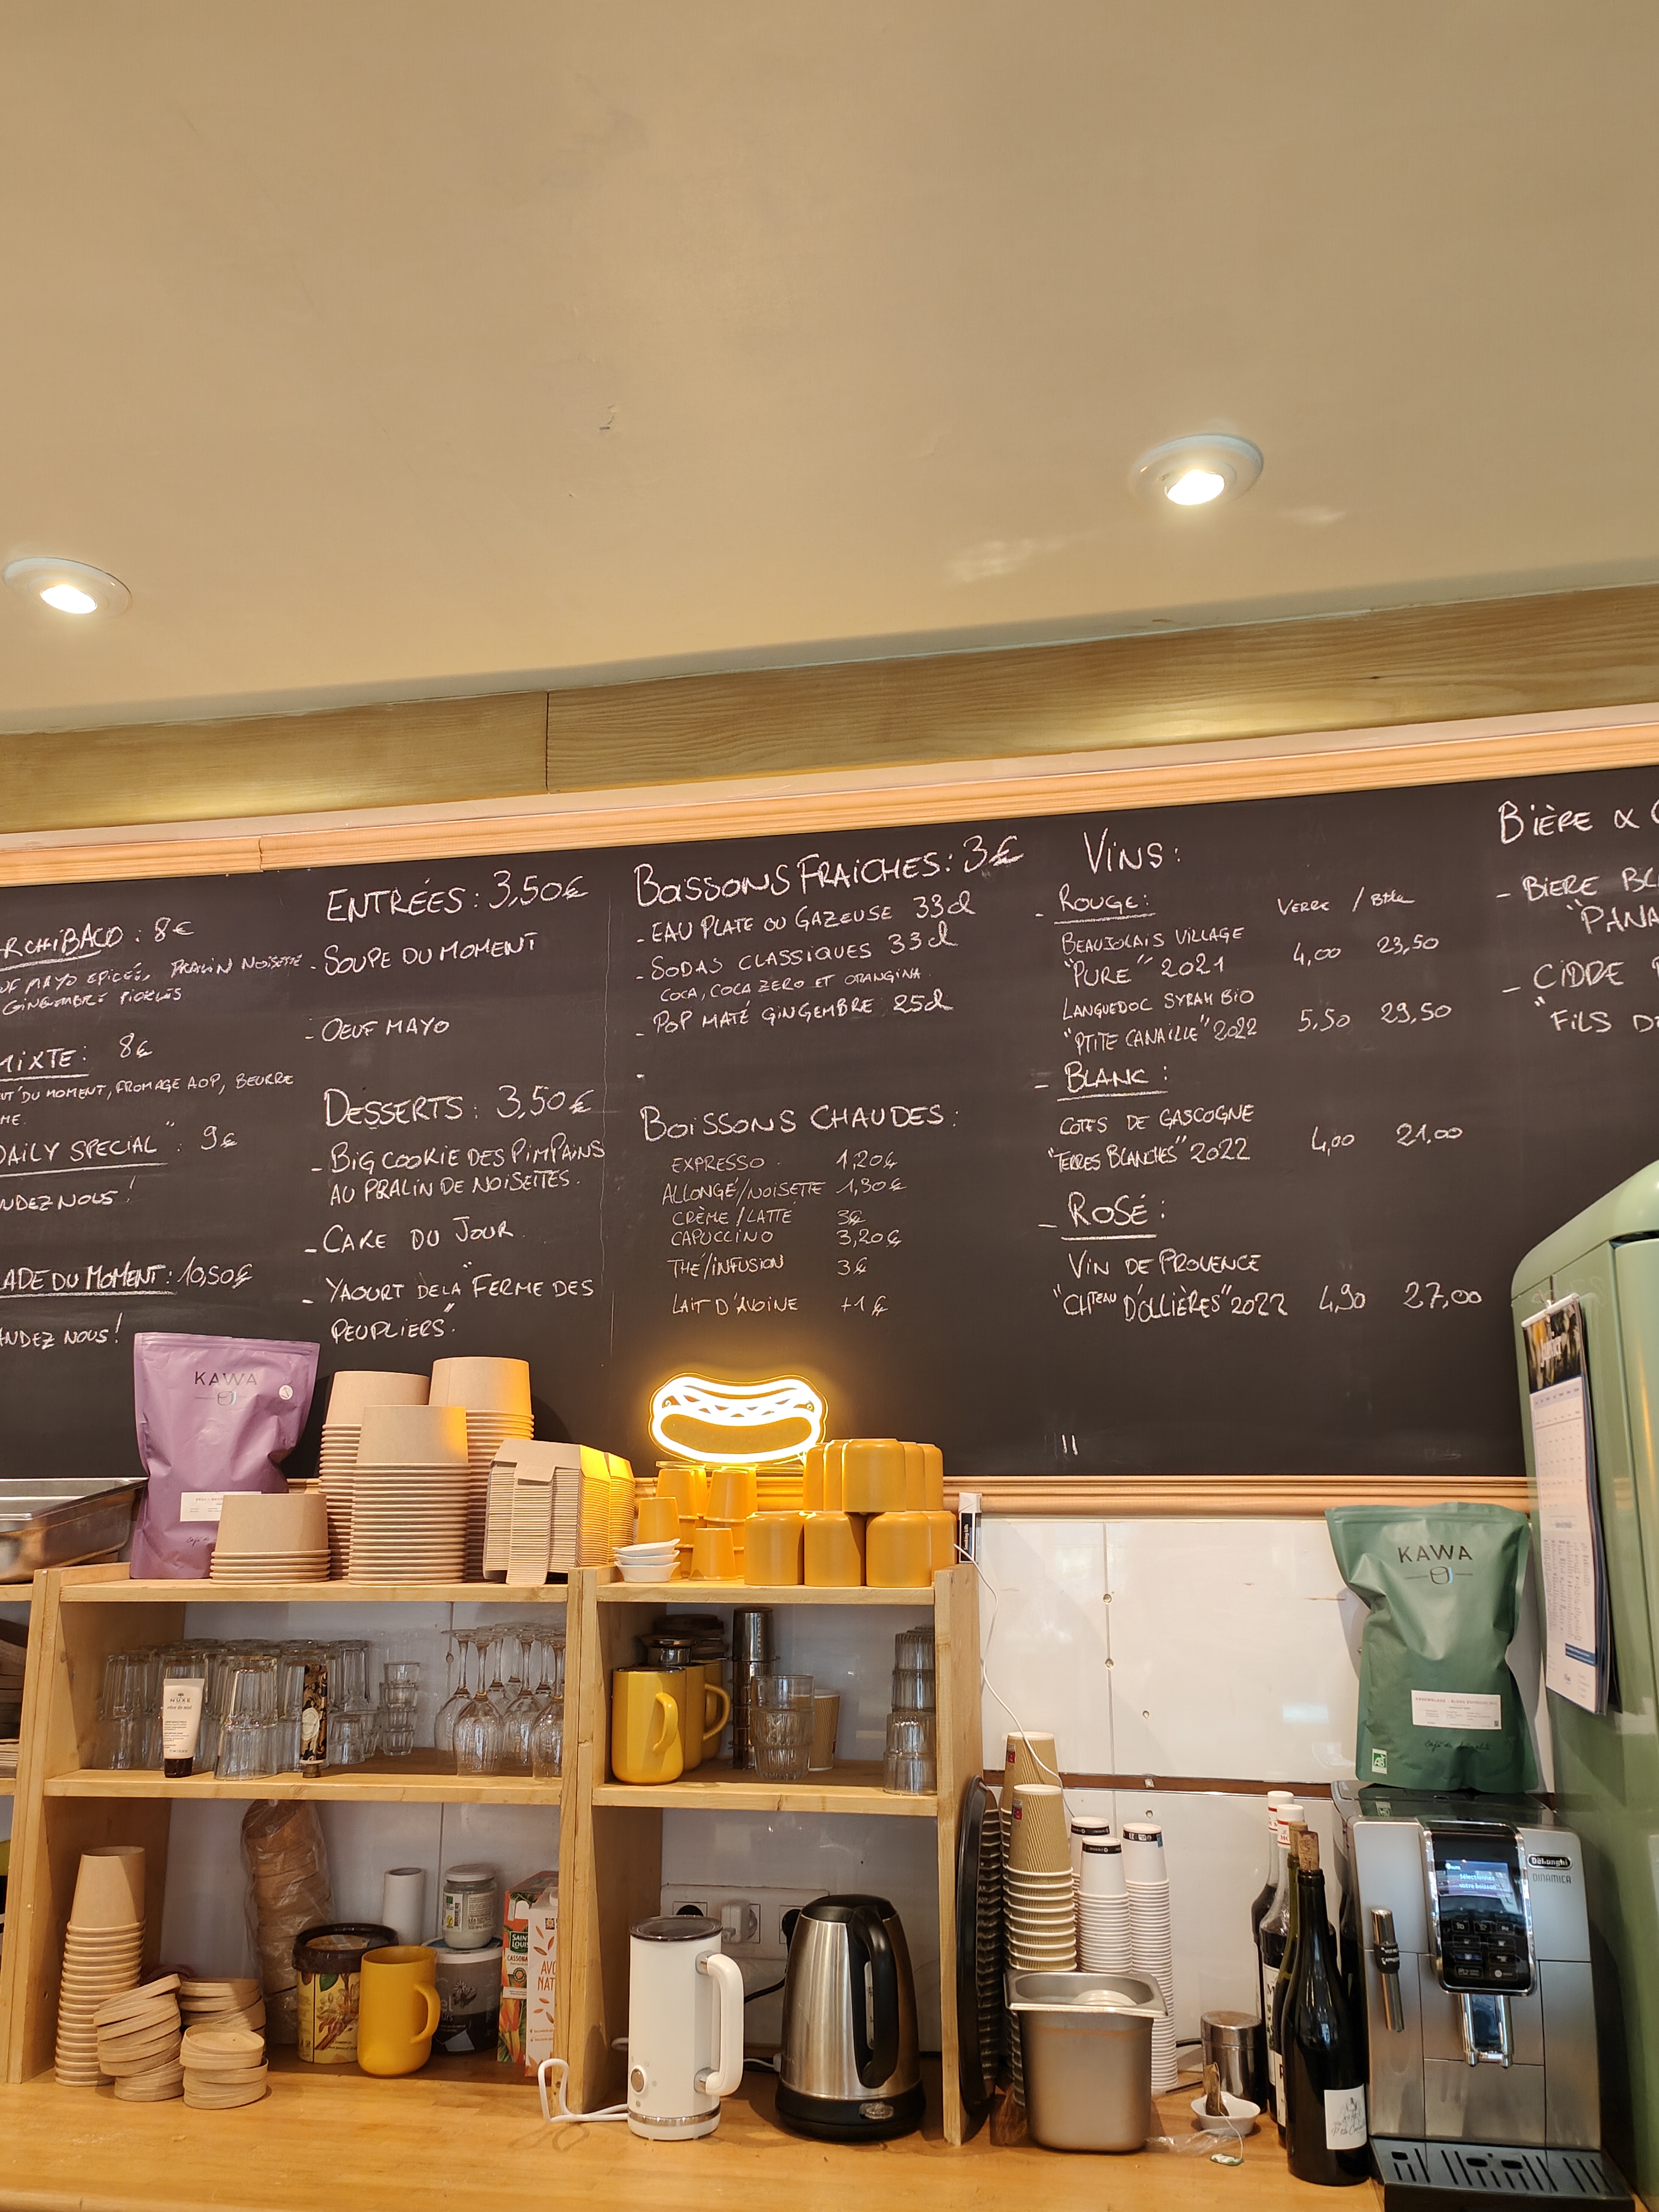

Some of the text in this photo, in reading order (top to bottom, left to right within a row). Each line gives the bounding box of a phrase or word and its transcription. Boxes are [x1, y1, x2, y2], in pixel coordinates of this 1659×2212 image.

[1498, 800, 1593, 845] BIÈRE
[1083, 827, 1181, 874] VINS:
[489, 869, 589, 909] 3,50€
[1058, 883, 1149, 913] ROUGE:
[1277, 898, 1330, 916] VERRE
[154, 916, 194, 942] 8€
[652, 921, 693, 943] EAU
[700, 914, 754, 940] PLATE
[764, 916, 786, 932] OU
[795, 905, 893, 932] GAZEUSE
[324, 932, 538, 976] SOUPE DU MOMENT
[651, 955, 723, 981] SODAS
[738, 942, 872, 970] CLASSIQUES
[1062, 927, 1439, 967] BEAUJOLAIS VILLAGE 4,00 23,50
[1161, 953, 1224, 978] 2021
[710, 983, 751, 997] COCA
[757, 978, 805, 993] ZERO
[814, 974, 835, 988] ET
[653, 1010, 693, 1034] POP
[702, 1000, 750, 1029] MATÉ
[761, 997, 874, 1027] GINGEMBRE
[1062, 997, 1153, 1021] LANGUEDOC
[1164, 992, 1213, 1009] SYRAH
[1221, 989, 1255, 1005] BIO
[1298, 1008, 1351, 1032] 5,50
[321, 1017, 450, 1042] OEUF MAYO
[1213, 1016, 1257, 1041] 2022
[119, 1032, 153, 1058] 8€
[116, 1078, 181, 1094] FROMAGE
[235, 1071, 294, 1089] BEURRE
[496, 1085, 595, 1120] 3,50€
[1060, 1104, 1255, 1135] COTES DE GASCOGNE
[201, 1125, 238, 1150] 9€
[1190, 1137, 1251, 1163] 2022
[1311, 1126, 1355, 1157] 4,00
[331, 1132, 605, 1175] BIG COOKIE DES PIMPAINS
[671, 1149, 898, 1173] EXPRESSO 1,20€
[330, 1184, 355, 1206] AU
[365, 1178, 433, 1202] PRALIN
[440, 1177, 464, 1195] DE
[323, 1224, 387, 1253] CAKE
[410, 1229, 440, 1251] DU
[671, 1228, 902, 1248] CAPUCCINO 3,20€
[1068, 1247, 1262, 1279] VIN DE PROVENCE
[51, 1272, 79, 1291] DU
[325, 1277, 404, 1303] YAOURT
[552, 1279, 594, 1298] DES
[672, 1293, 711, 1314] LAIT
[1231, 1292, 1288, 1316] 2022
[1403, 1281, 1482, 1309] 27,00
[194, 1371, 257, 1386] KAWA
[1398, 1545, 1473, 1563] KAWA
[1532, 1873, 1572, 1884] DINAMICA
